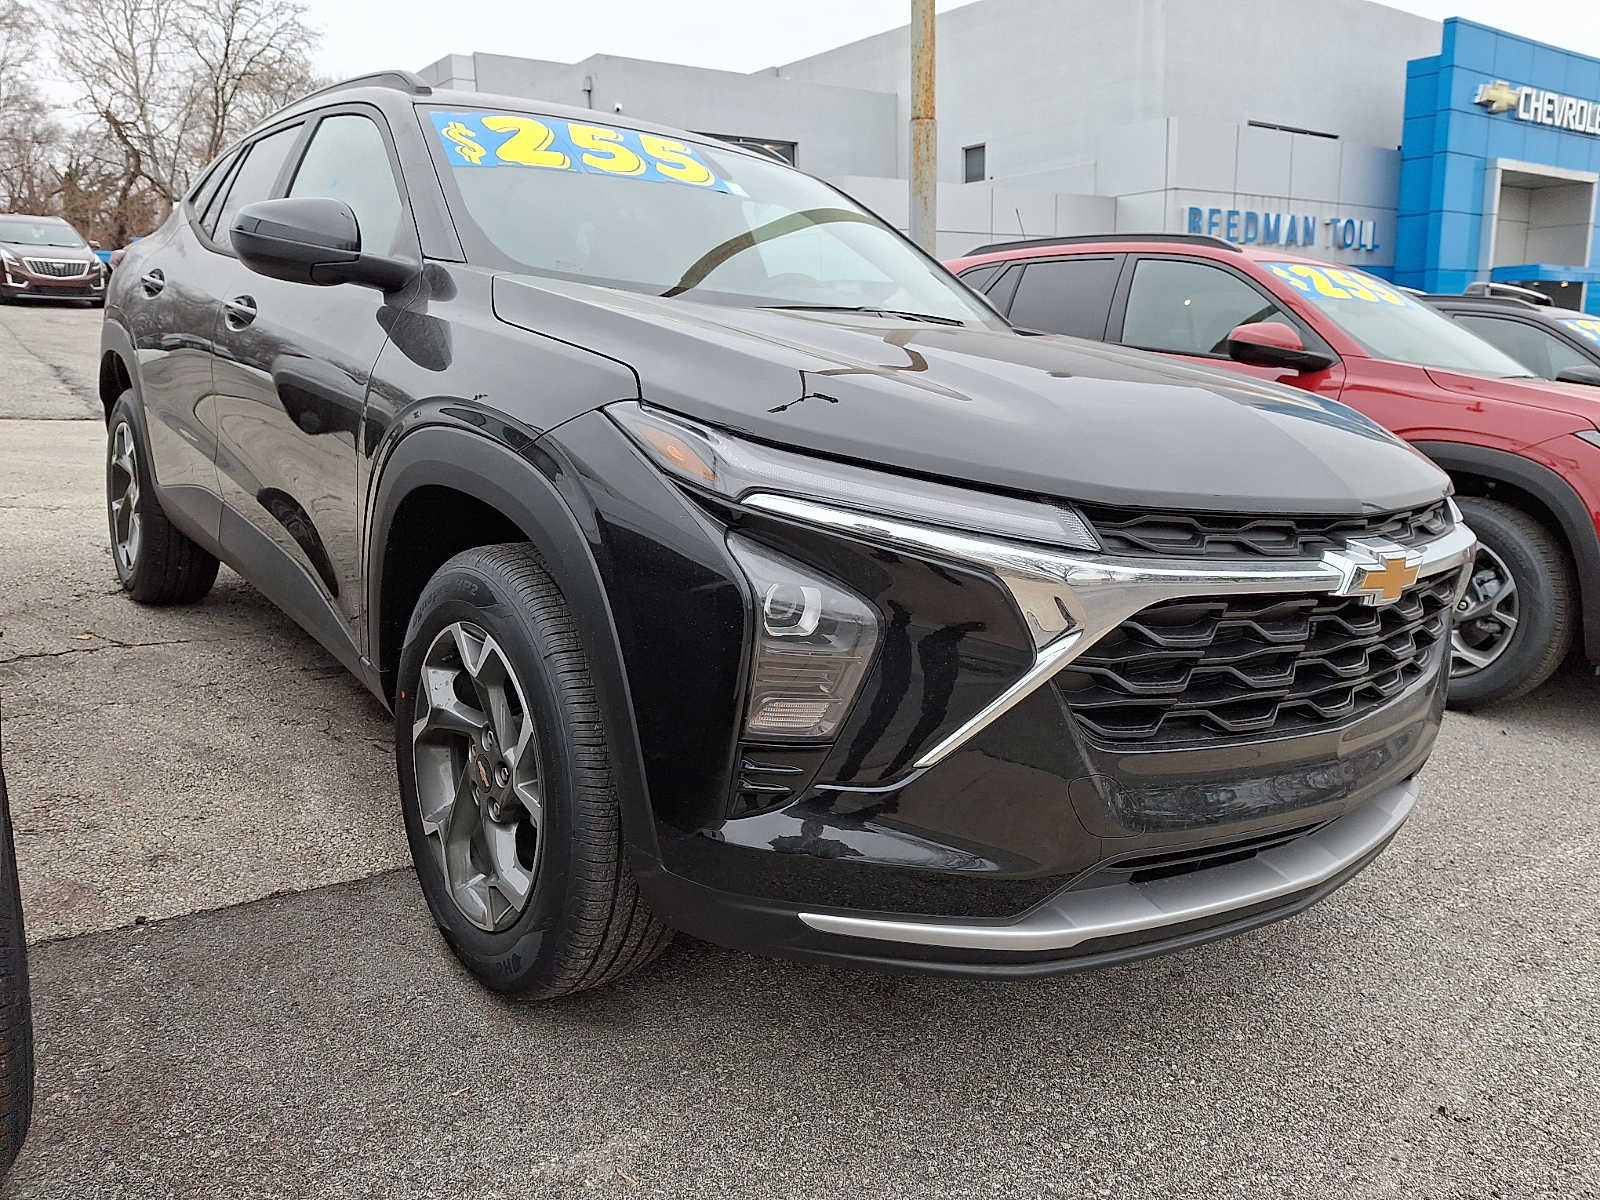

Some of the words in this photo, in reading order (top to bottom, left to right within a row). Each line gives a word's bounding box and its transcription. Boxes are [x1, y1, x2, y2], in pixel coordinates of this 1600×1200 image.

[441, 116, 716, 187] $255
[1329, 217, 1380, 250] TOLL
[1270, 265, 1405, 306] $255
